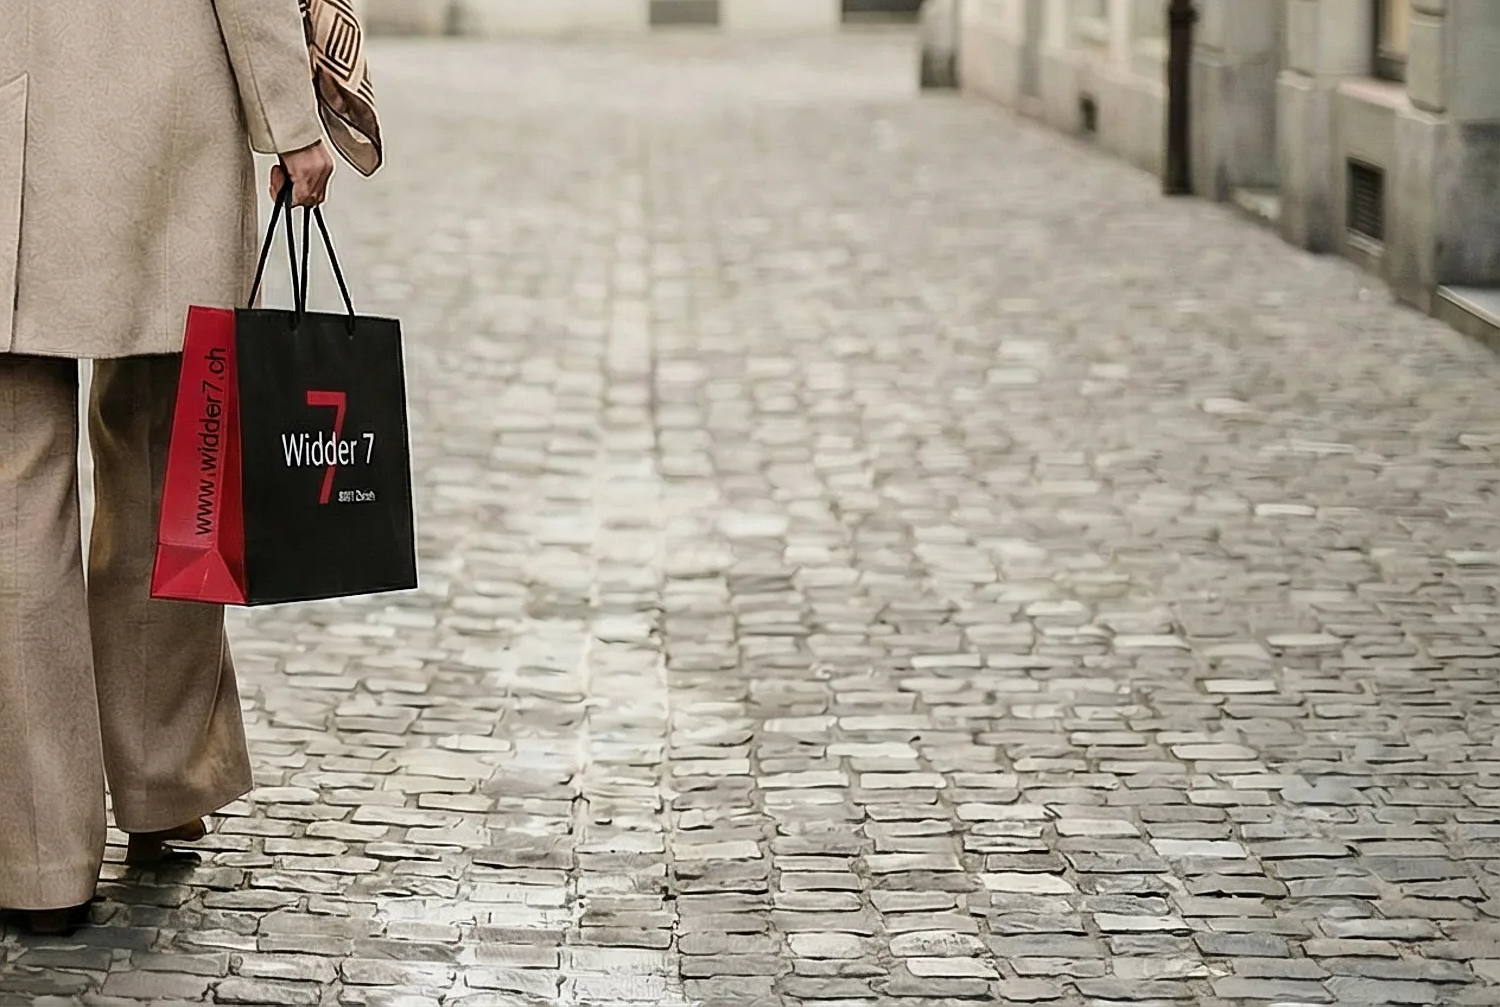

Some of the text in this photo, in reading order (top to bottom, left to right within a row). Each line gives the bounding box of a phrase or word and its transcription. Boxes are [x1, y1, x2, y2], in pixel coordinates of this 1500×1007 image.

[195, 347, 227, 536] www.widder7.ch
[281, 430, 375, 467] Widder 7
[306, 390, 347, 505] 7
